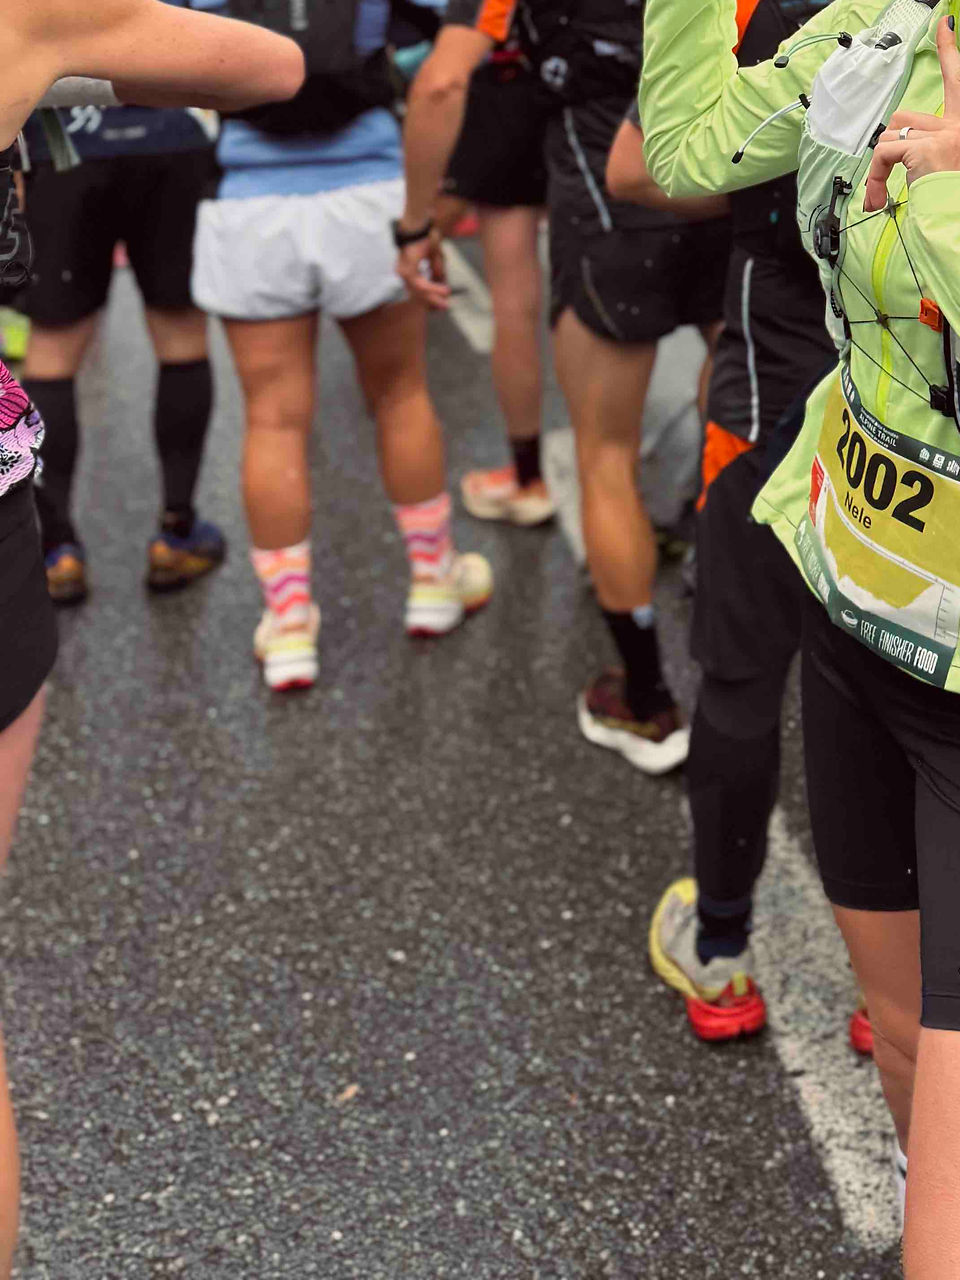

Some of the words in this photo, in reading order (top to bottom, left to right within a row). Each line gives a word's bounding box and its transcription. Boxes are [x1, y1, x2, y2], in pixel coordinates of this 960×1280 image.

[859, 413, 877, 434] ALPINE
[877, 429, 897, 447] TRAIL
[837, 408, 934, 533] 2002
[844, 491, 873, 529] Nele
[860, 620, 877, 644] FREE
[878, 629, 915, 664] FINISHER
[913, 646, 939, 675] FOOD
